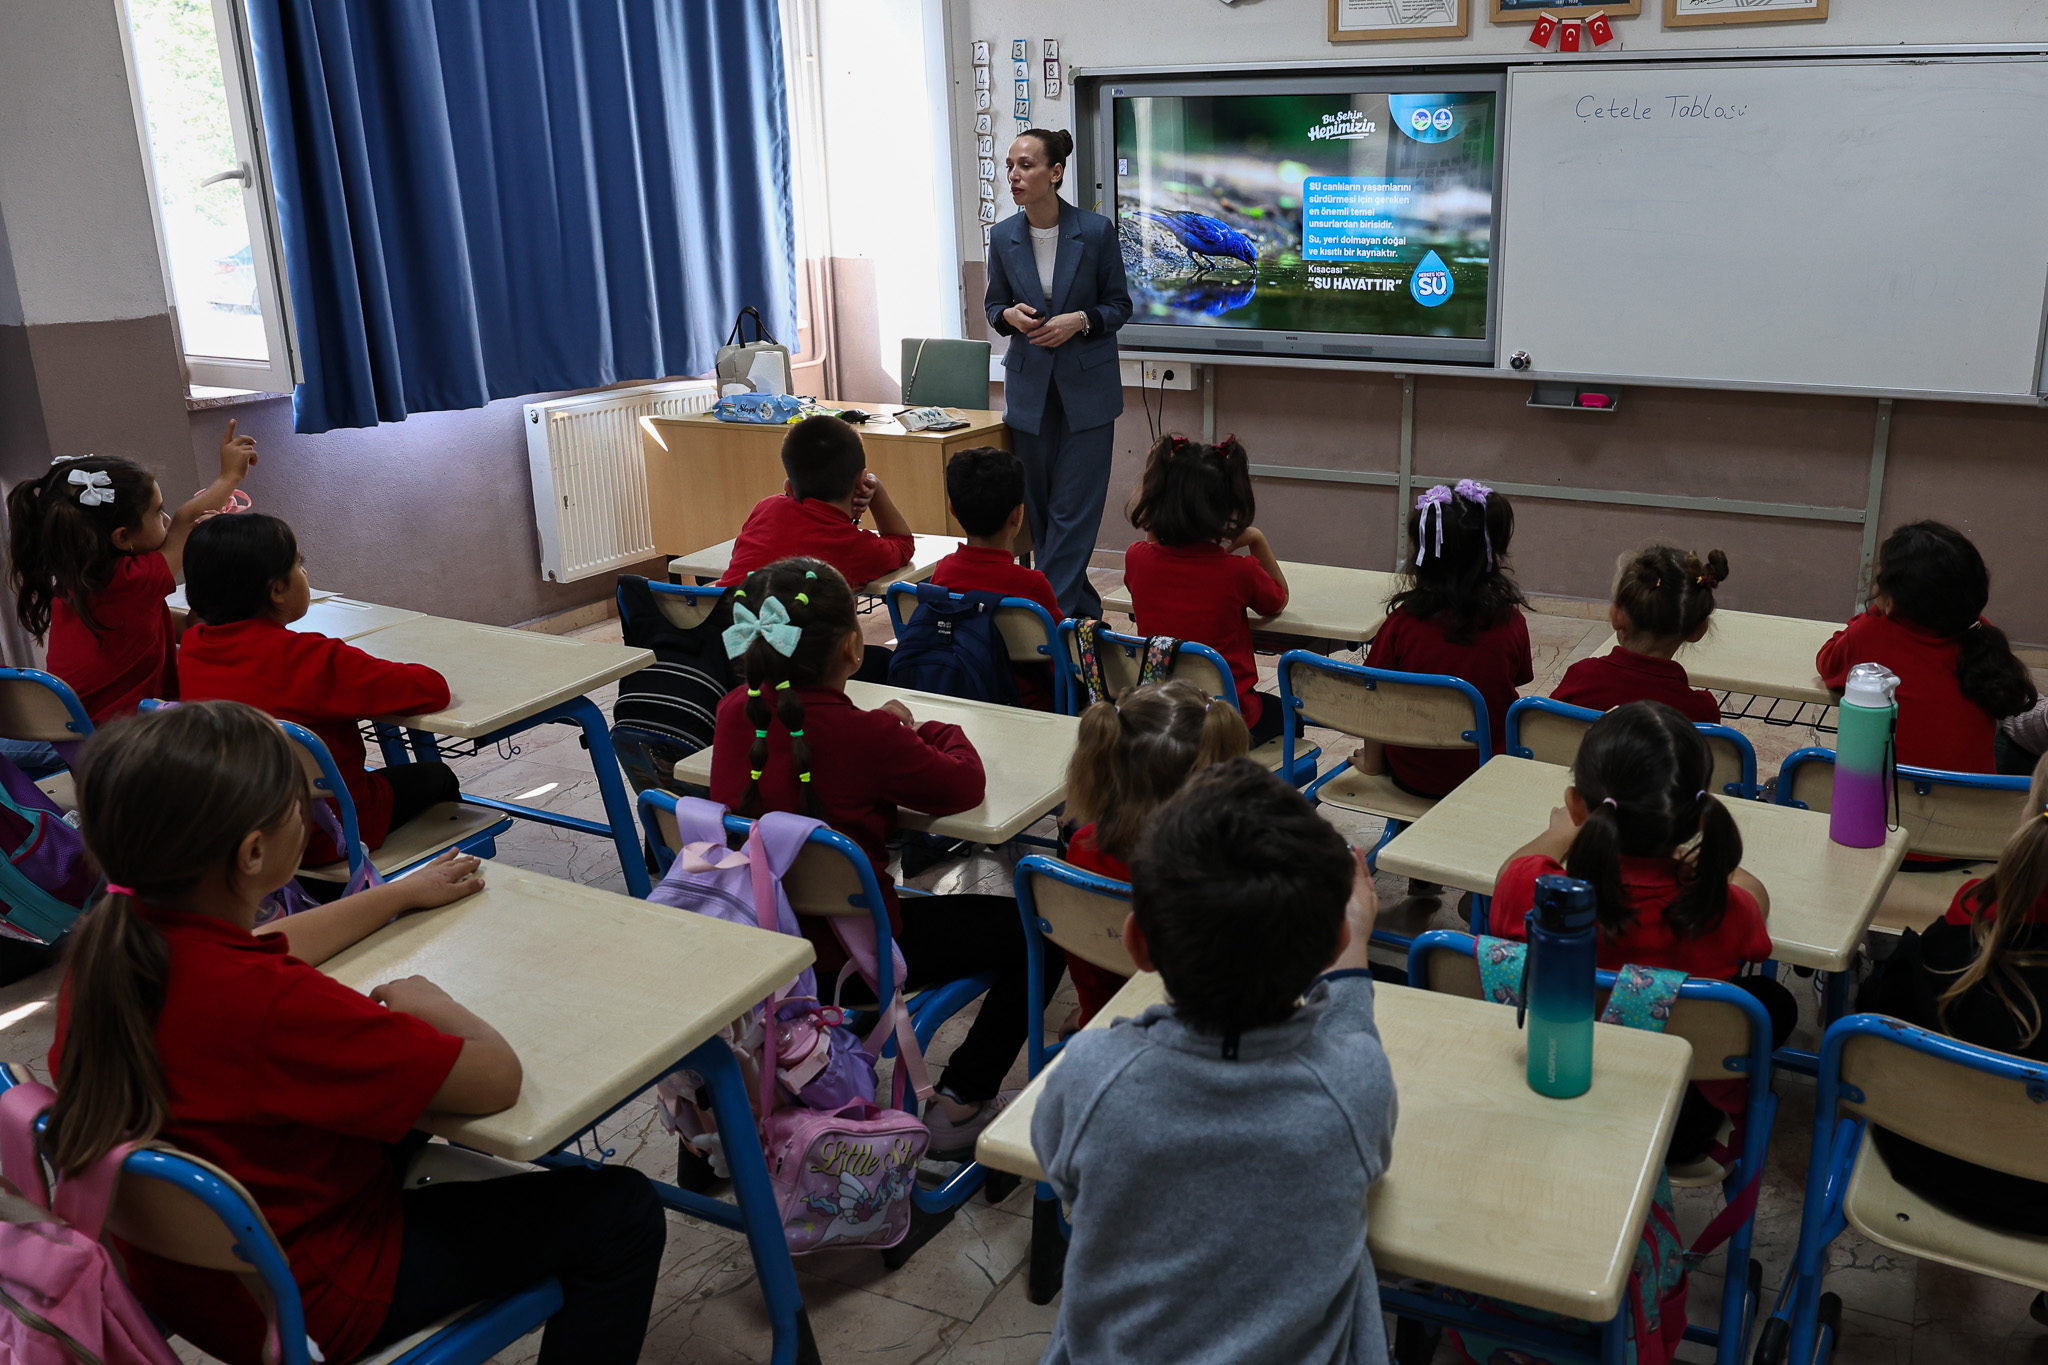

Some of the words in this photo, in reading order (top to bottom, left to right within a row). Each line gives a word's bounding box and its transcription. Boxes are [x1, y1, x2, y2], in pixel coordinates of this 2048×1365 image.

[977, 45, 985, 60] 2
[1015, 44, 1022, 57] 3
[1046, 44, 1054, 57] 4
[1016, 64, 1023, 77] 6
[1048, 64, 1055, 77] 8
[979, 70, 987, 85] 4
[1018, 84, 1024, 97] 9
[1047, 82, 1058, 94] 12
[979, 93, 986, 108] 6
[1016, 102, 1027, 115] 12
[1575, 95, 1651, 123] Çetele
[1322, 114, 1335, 124] Bu
[1336, 110, 1363, 123] Şehir
[980, 117, 988, 131] 8
[1018, 121, 1028, 133] 15
[1307, 118, 1376, 141] Hepimizin
[981, 139, 992, 153] 10
[981, 162, 993, 176] 12
[1309, 182, 1321, 191] SU
[1322, 182, 1361, 191] canlıların
[1362, 183, 1412, 193] yaşamlarını
[1309, 195, 1357, 204] sürdürmesi
[1357, 195, 1373, 205] için
[1375, 196, 1410, 205] gereken
[982, 206, 993, 219] 16
[1309, 208, 1320, 216] en
[1321, 207, 1349, 216] önemli
[1350, 208, 1375, 216] temel
[1308, 219, 1358, 228] unsurlardan
[1360, 220, 1394, 229] birisidir.
[1308, 235, 1321, 244] Su,
[1323, 235, 1339, 245] yeri
[1340, 236, 1381, 246] dolmayan
[1382, 236, 1406, 247] doğal
[1320, 247, 1342, 256] kısıtlı
[1344, 248, 1355, 256] bir
[1356, 248, 1398, 259] kaynaktır.
[1308, 264, 1343, 274] Kısacası
[1418, 276, 1446, 296] SU
[808, 1139, 880, 1177] Little
